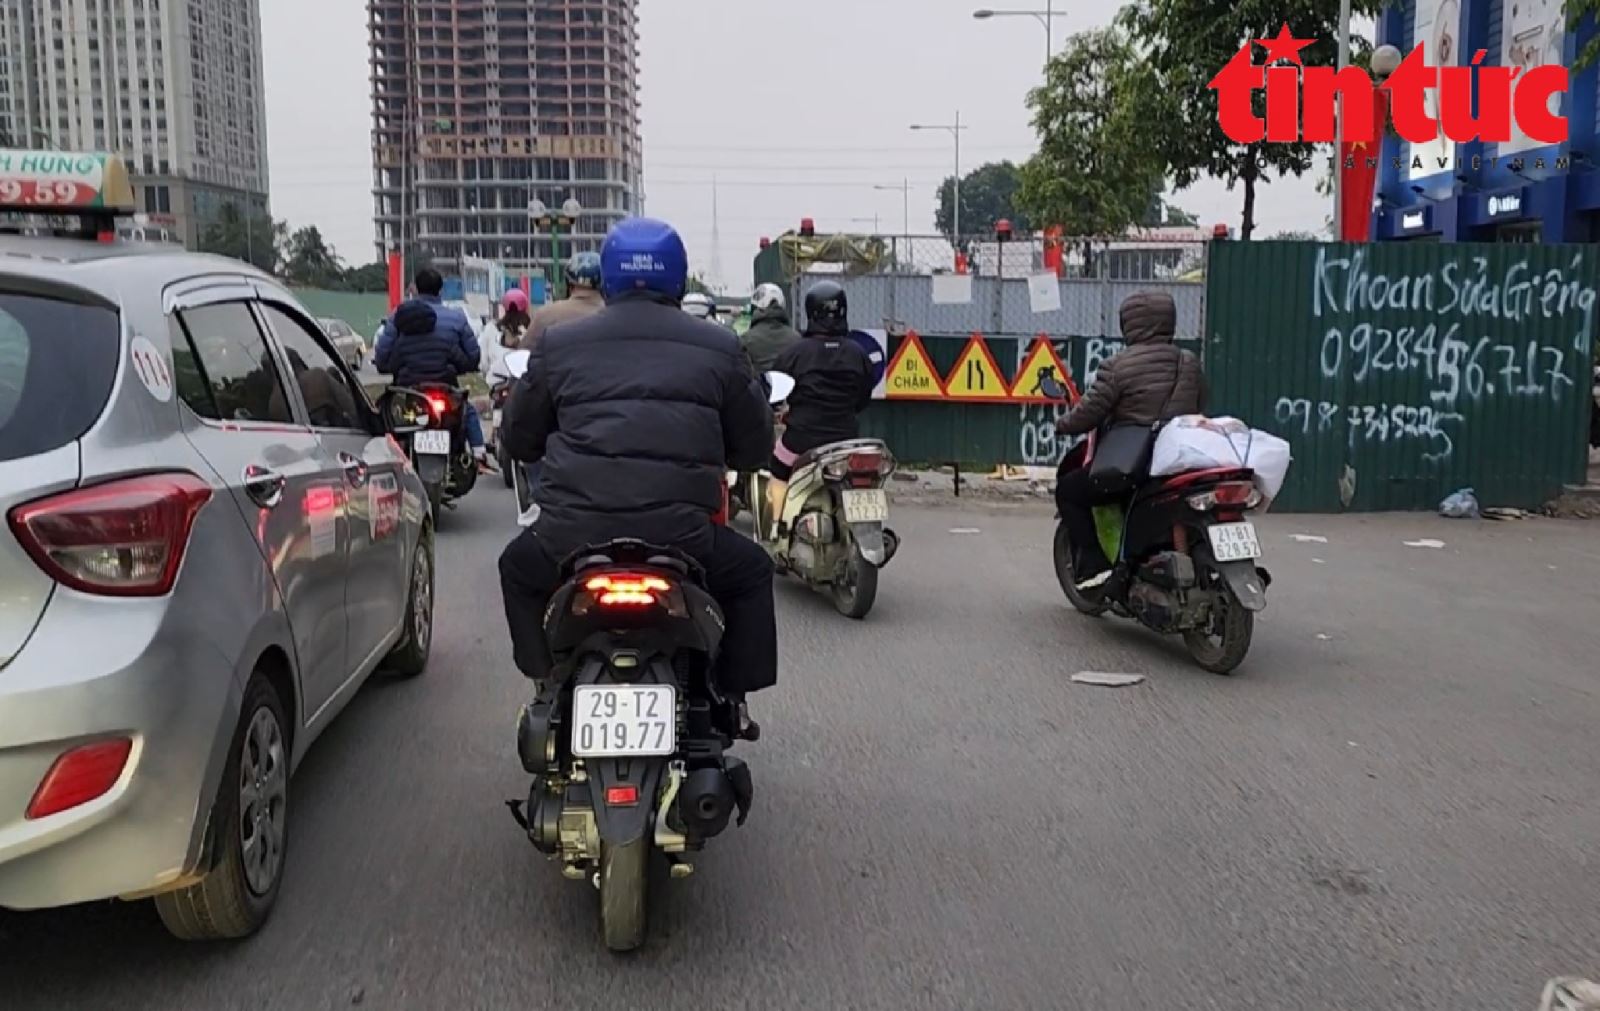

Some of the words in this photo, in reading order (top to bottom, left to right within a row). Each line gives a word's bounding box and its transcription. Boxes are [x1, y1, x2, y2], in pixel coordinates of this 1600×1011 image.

[1313, 246, 1434, 317] Khoan
[590, 691, 659, 718] 29-T2
[581, 722, 666, 751] 019.77
